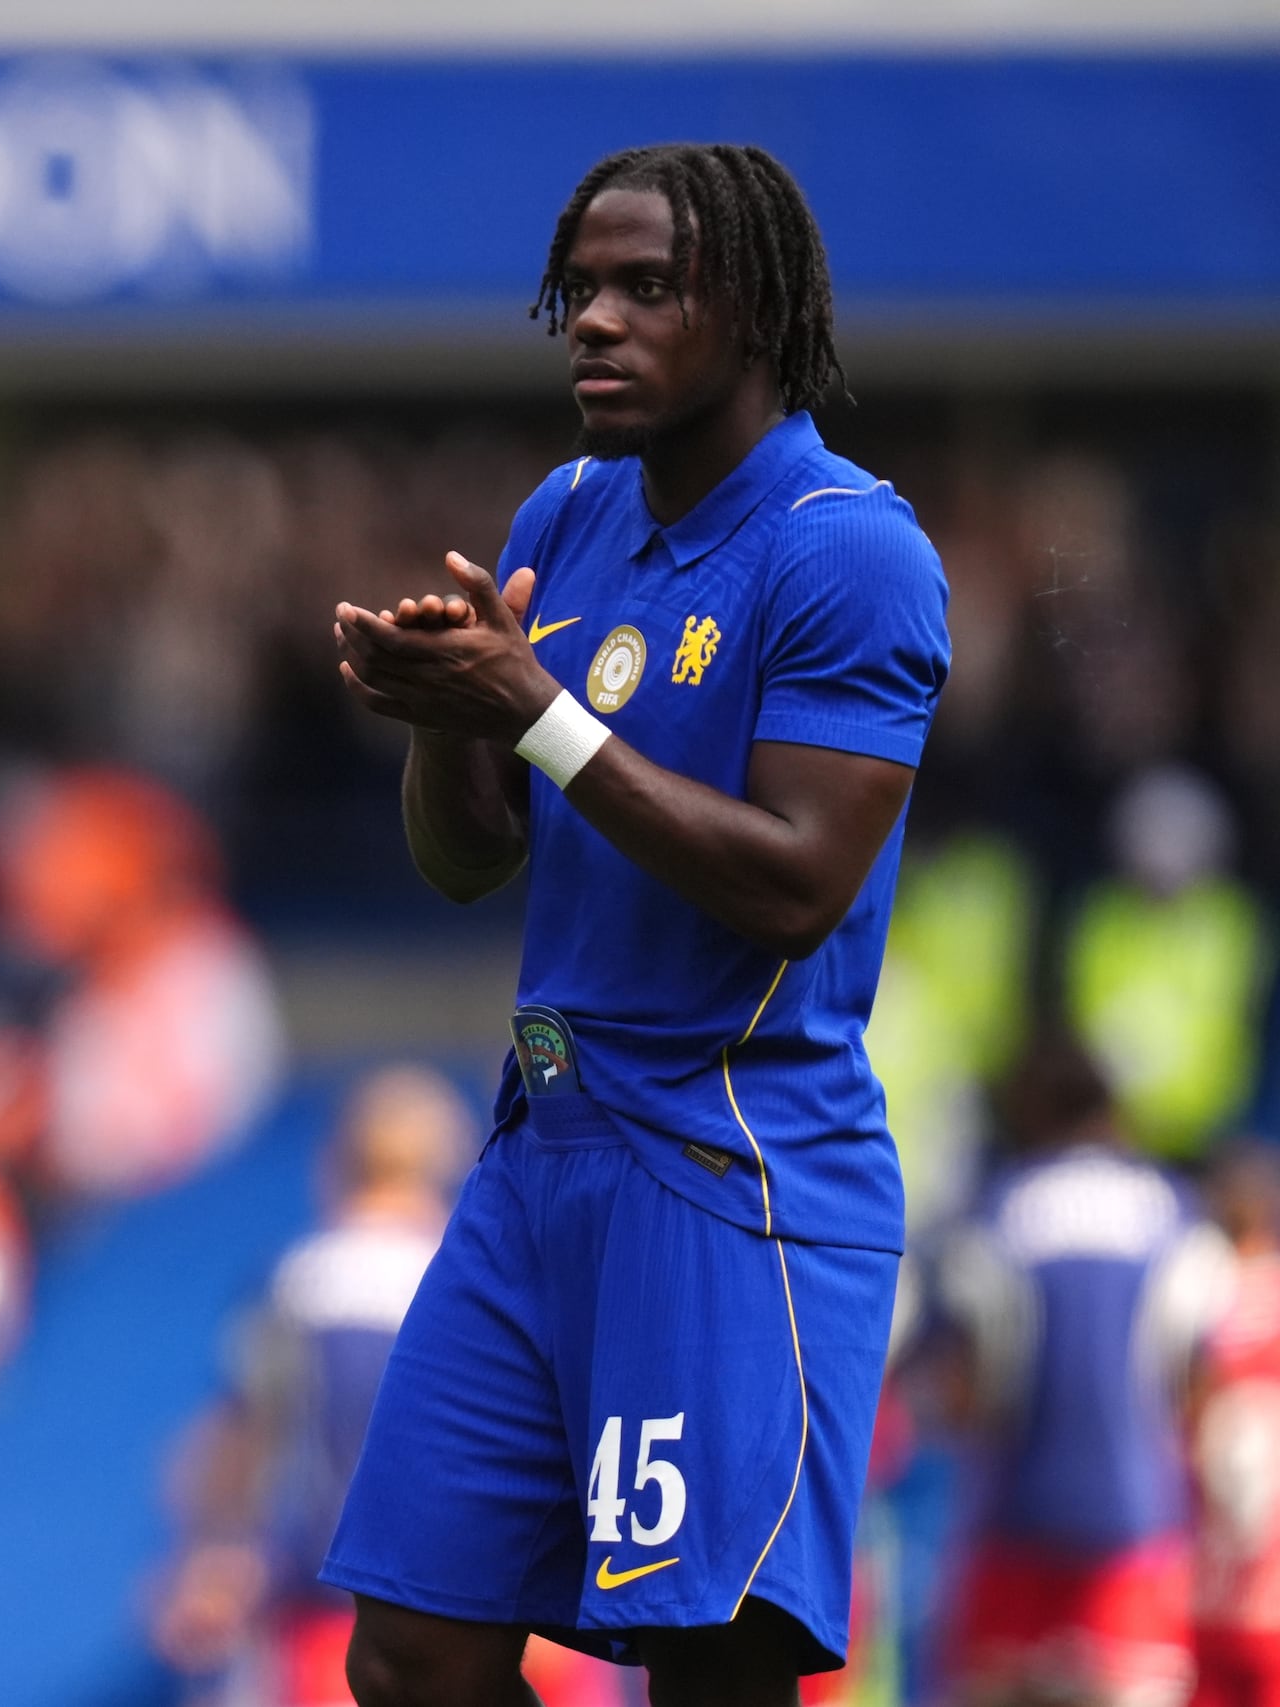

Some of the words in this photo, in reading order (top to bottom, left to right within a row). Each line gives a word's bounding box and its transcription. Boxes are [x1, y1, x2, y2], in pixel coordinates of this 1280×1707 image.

[593, 638, 616, 677] WORLD
[616, 633, 642, 682] CHAMPIONS
[596, 691, 620, 706] FIFA
[587, 1411, 687, 1547] 45
